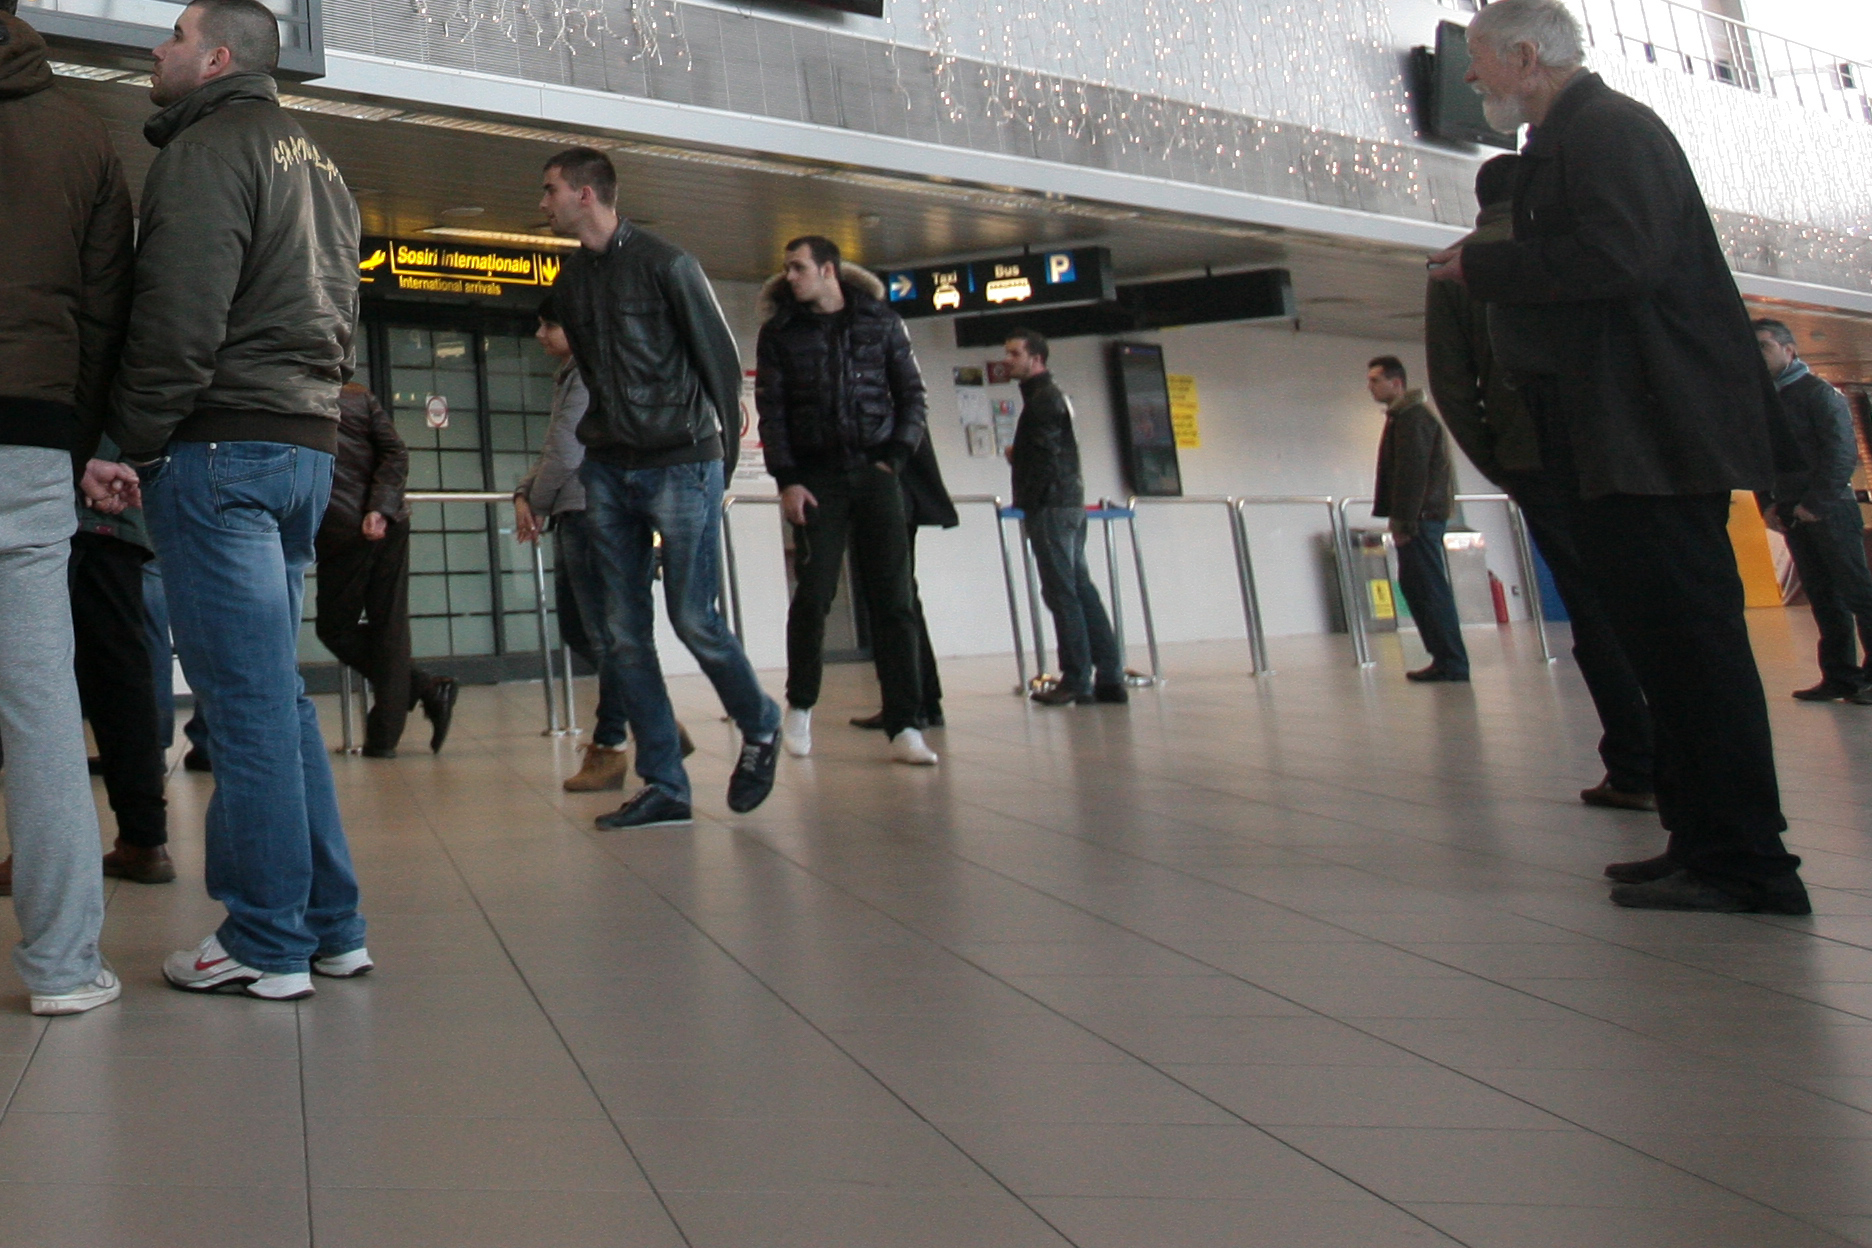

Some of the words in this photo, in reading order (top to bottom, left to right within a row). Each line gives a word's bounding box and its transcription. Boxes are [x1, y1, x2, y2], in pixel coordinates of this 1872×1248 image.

[397, 245, 439, 266] Sosiri
[932, 270, 959, 286] Taxi
[994, 264, 1021, 279] Bus
[1050, 253, 1070, 283] P
[399, 274, 463, 293] International
[464, 280, 502, 296] arrivals
